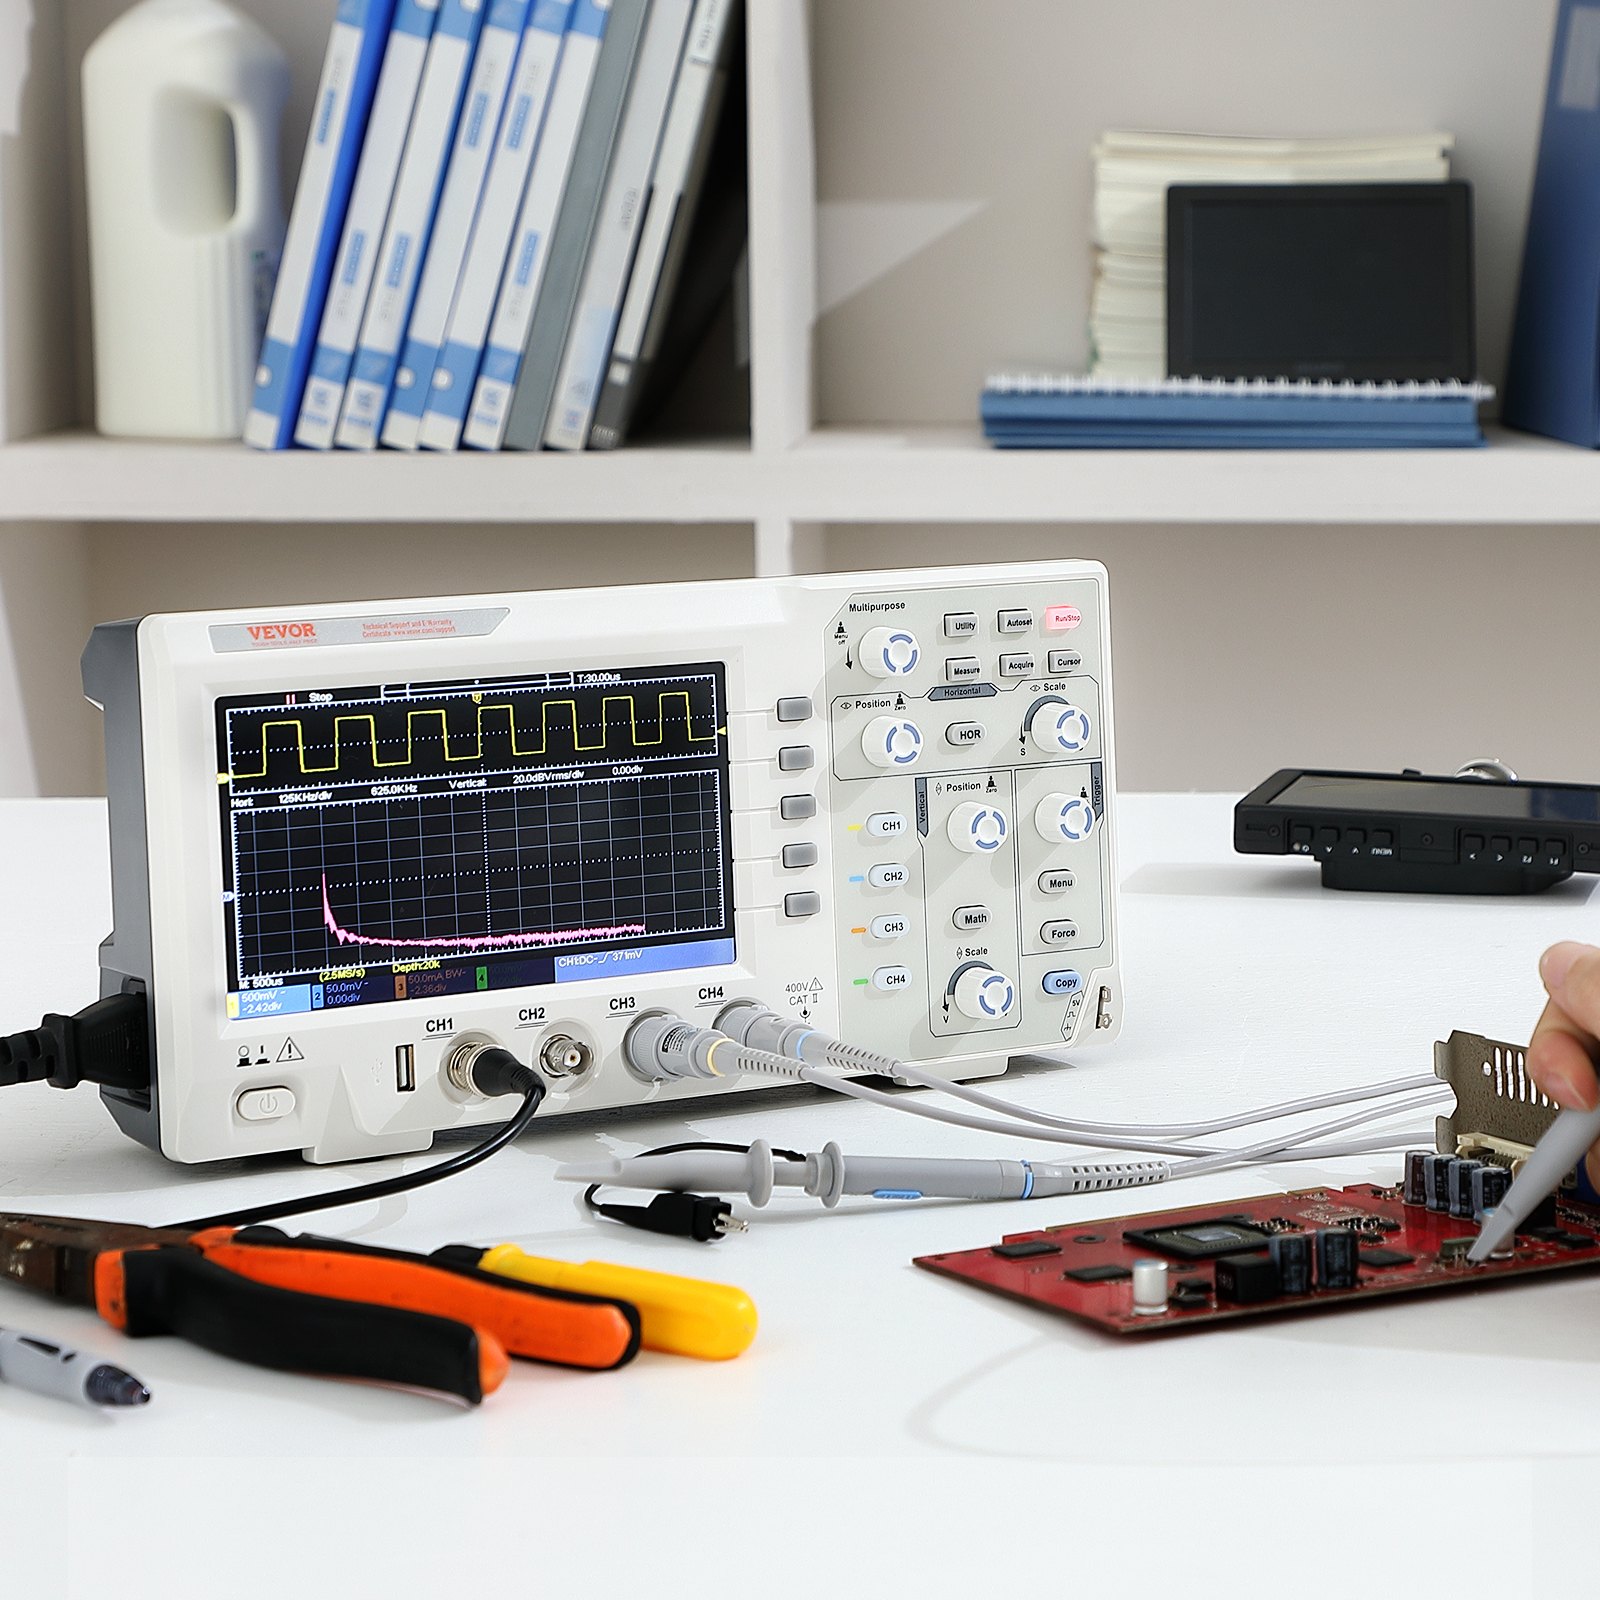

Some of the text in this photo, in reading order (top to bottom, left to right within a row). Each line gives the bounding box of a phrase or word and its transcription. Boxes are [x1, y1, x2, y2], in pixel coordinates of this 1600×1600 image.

[849, 601, 906, 613] Multipurpose
[1006, 617, 1033, 628] Autoset
[1055, 613, 1081, 624] Run/Stop
[247, 623, 316, 640] VEVOR
[955, 621, 976, 631] Utility
[1008, 660, 1034, 671] Acquire
[1057, 657, 1081, 667] Cursor
[953, 666, 981, 676] Measure
[309, 672, 621, 703] Stop T:30.00us
[944, 686, 981, 697] Horizontal
[1043, 681, 1066, 692] Scale
[855, 699, 891, 709] Position
[960, 729, 981, 741] HOR
[1020, 748, 1026, 756] S
[278, 791, 333, 804] 125KHz/div
[371, 784, 418, 796] 625.0KHz
[513, 770, 585, 784] 20.0dBVrms/div
[612, 765, 644, 776] 0.00div
[946, 781, 981, 793] Position
[1093, 775, 1101, 807] Trigger
[882, 820, 902, 832] CH1
[1371, 847, 1393, 856] MENU
[883, 871, 903, 883] CH2
[1049, 877, 1073, 889] Menu
[964, 912, 987, 924] Math
[884, 922, 904, 933] CH3
[1051, 928, 1076, 939] Force
[612, 949, 643, 962] 371mV
[964, 946, 988, 957] Scale
[252, 978, 284, 989] 500us
[392, 960, 441, 974] Depth:20k
[479, 974, 485, 982] 4
[886, 974, 906, 986] CH4
[326, 981, 363, 993] 50.0mV
[785, 981, 809, 993] 400V
[1055, 977, 1078, 989] Copy
[241, 989, 278, 1003] 500mV
[314, 992, 321, 1001] 2
[327, 993, 361, 1005] 0.00div
[698, 986, 724, 1000] CH4
[609, 996, 636, 1011] CH3
[789, 994, 809, 1006] CAT
[1072, 999, 1081, 1007] 5V
[518, 1007, 545, 1021] CH2
[943, 1015, 949, 1024] V
[425, 1018, 454, 1033] CH1
